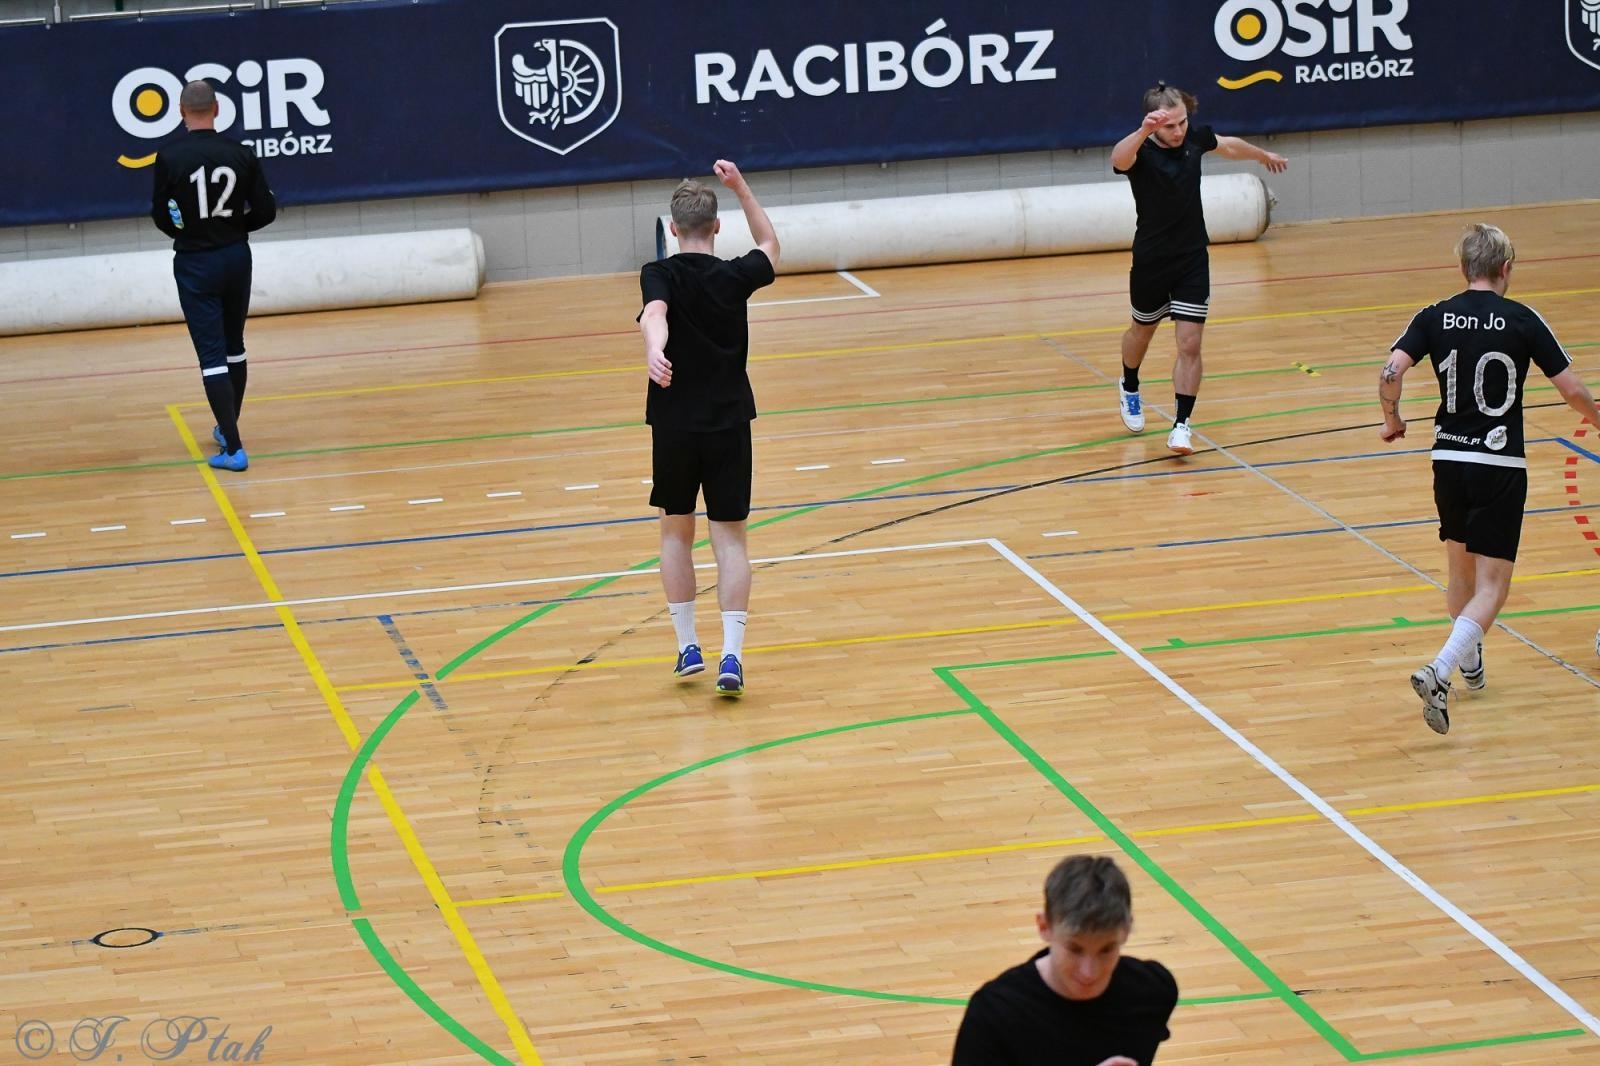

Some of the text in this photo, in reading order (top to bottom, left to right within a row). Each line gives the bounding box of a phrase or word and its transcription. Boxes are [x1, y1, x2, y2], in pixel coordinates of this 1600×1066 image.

[694, 18, 1057, 104] RACIBÓRZ
[1295, 54, 1414, 84] RACIBÓRZ
[189, 165, 237, 219] 12
[1443, 312, 1506, 330] Bon Jo
[1438, 348, 1517, 417] 10
